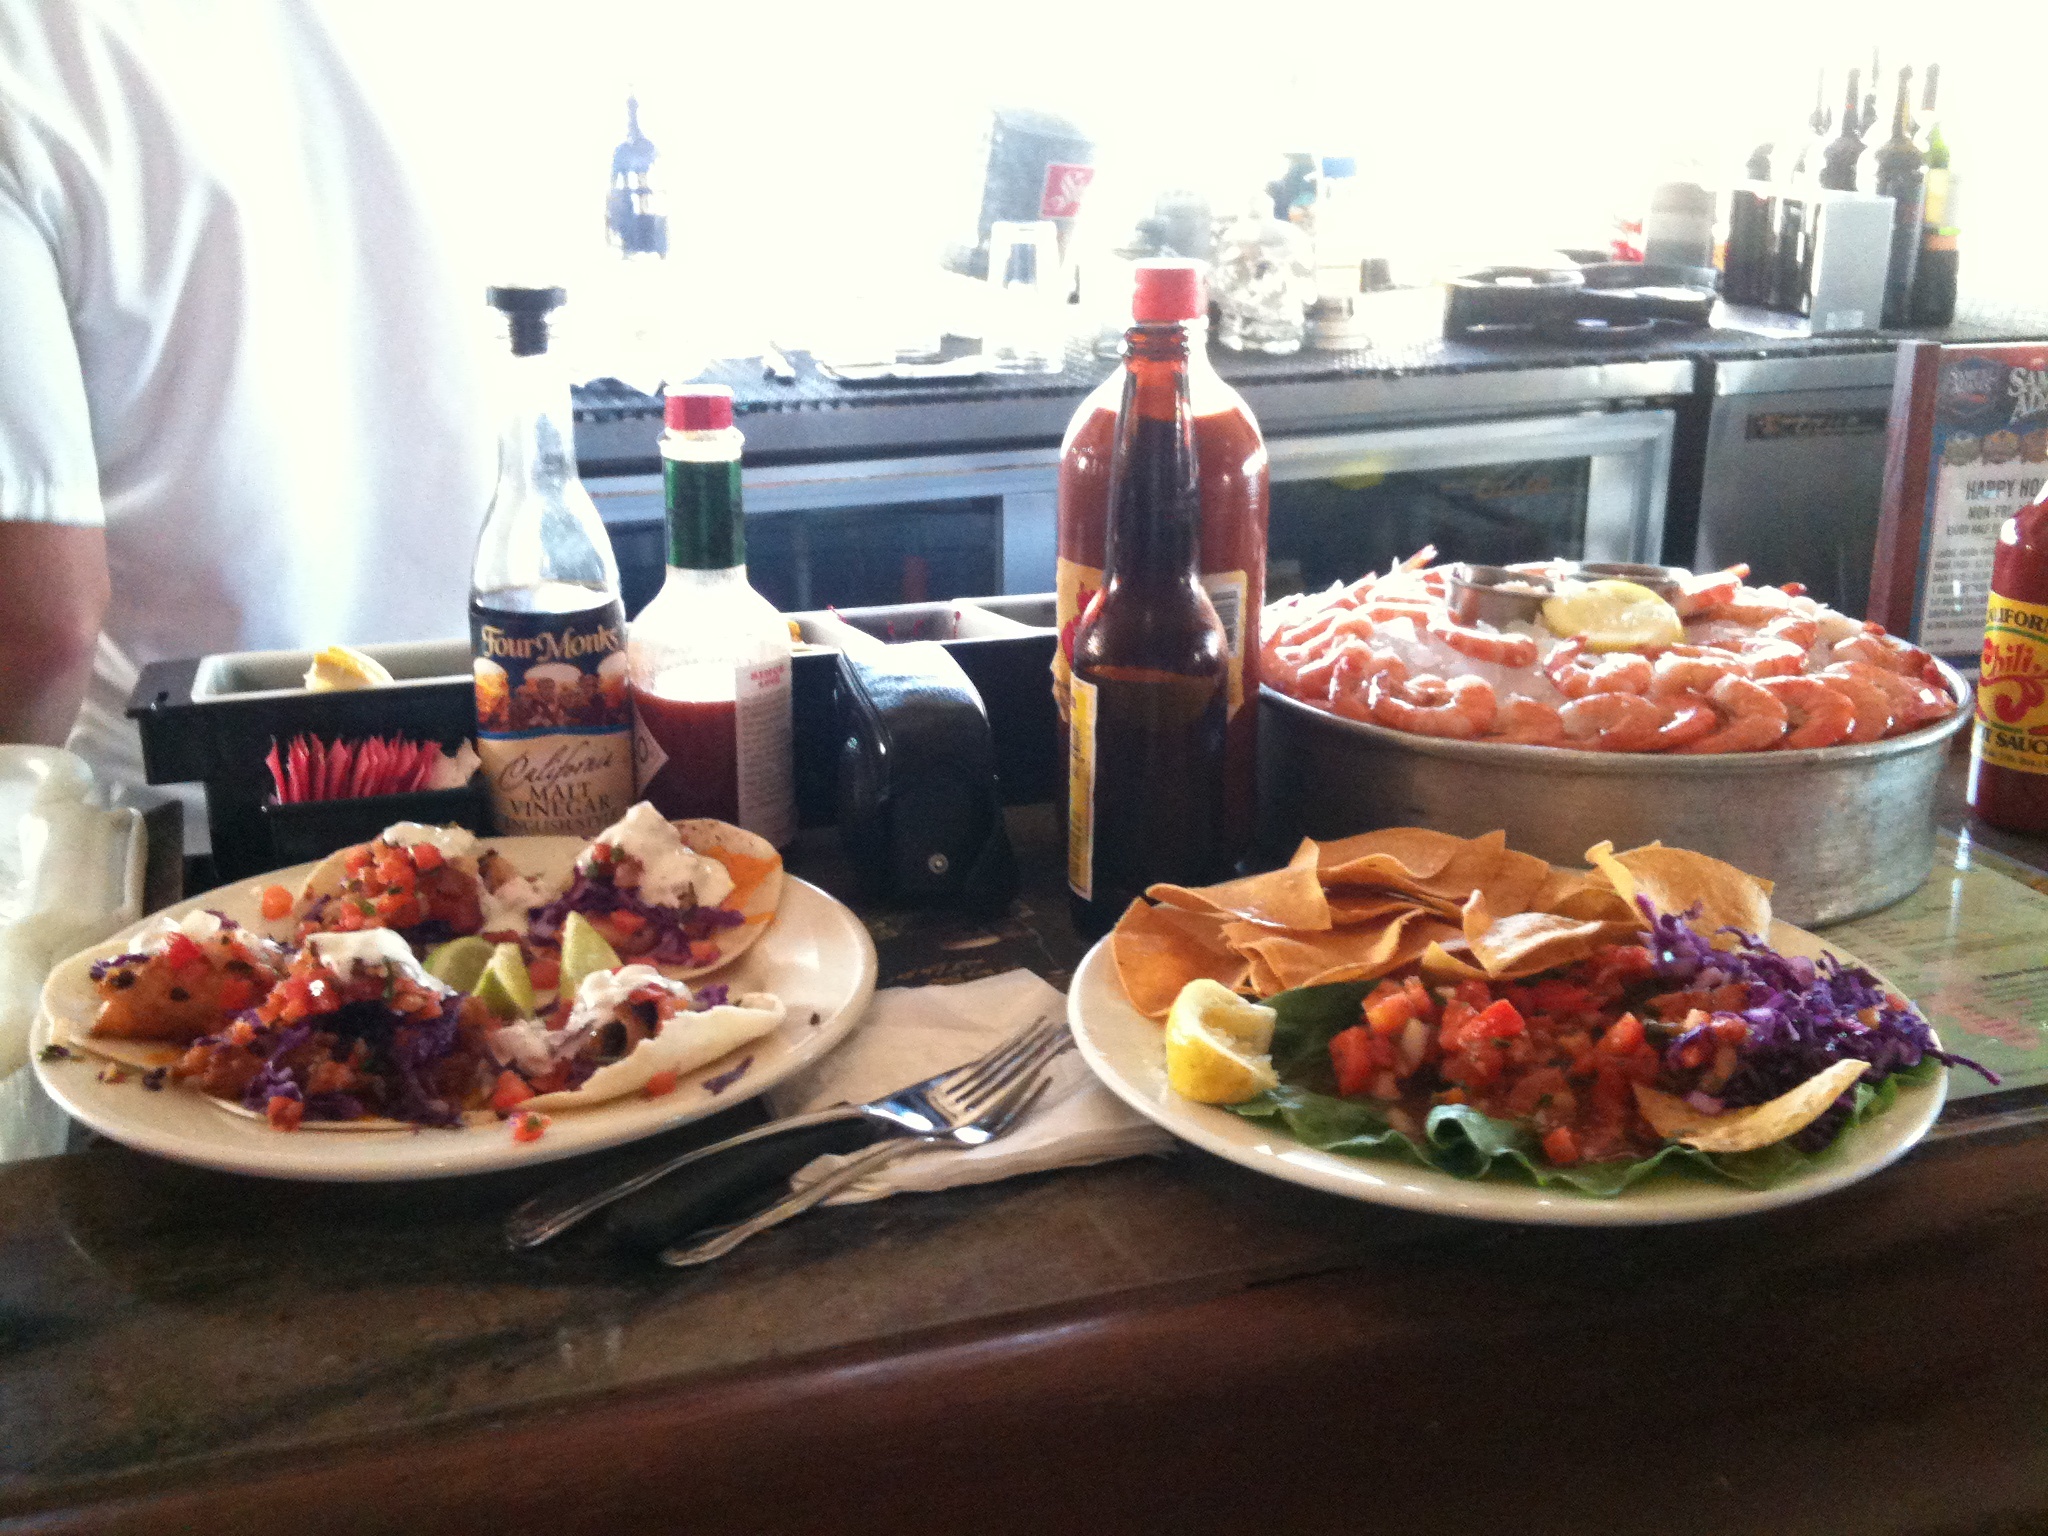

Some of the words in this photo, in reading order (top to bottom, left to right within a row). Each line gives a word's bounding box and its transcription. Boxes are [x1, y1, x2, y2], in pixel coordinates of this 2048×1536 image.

[1965, 479, 2016, 500] HAPPY
[482, 625, 535, 658] Four
[536, 625, 619, 662] Monks
[1996, 732, 2048, 755] SAUC
[530, 781, 591, 802] MALT
[509, 792, 612, 818] VINEGAR
